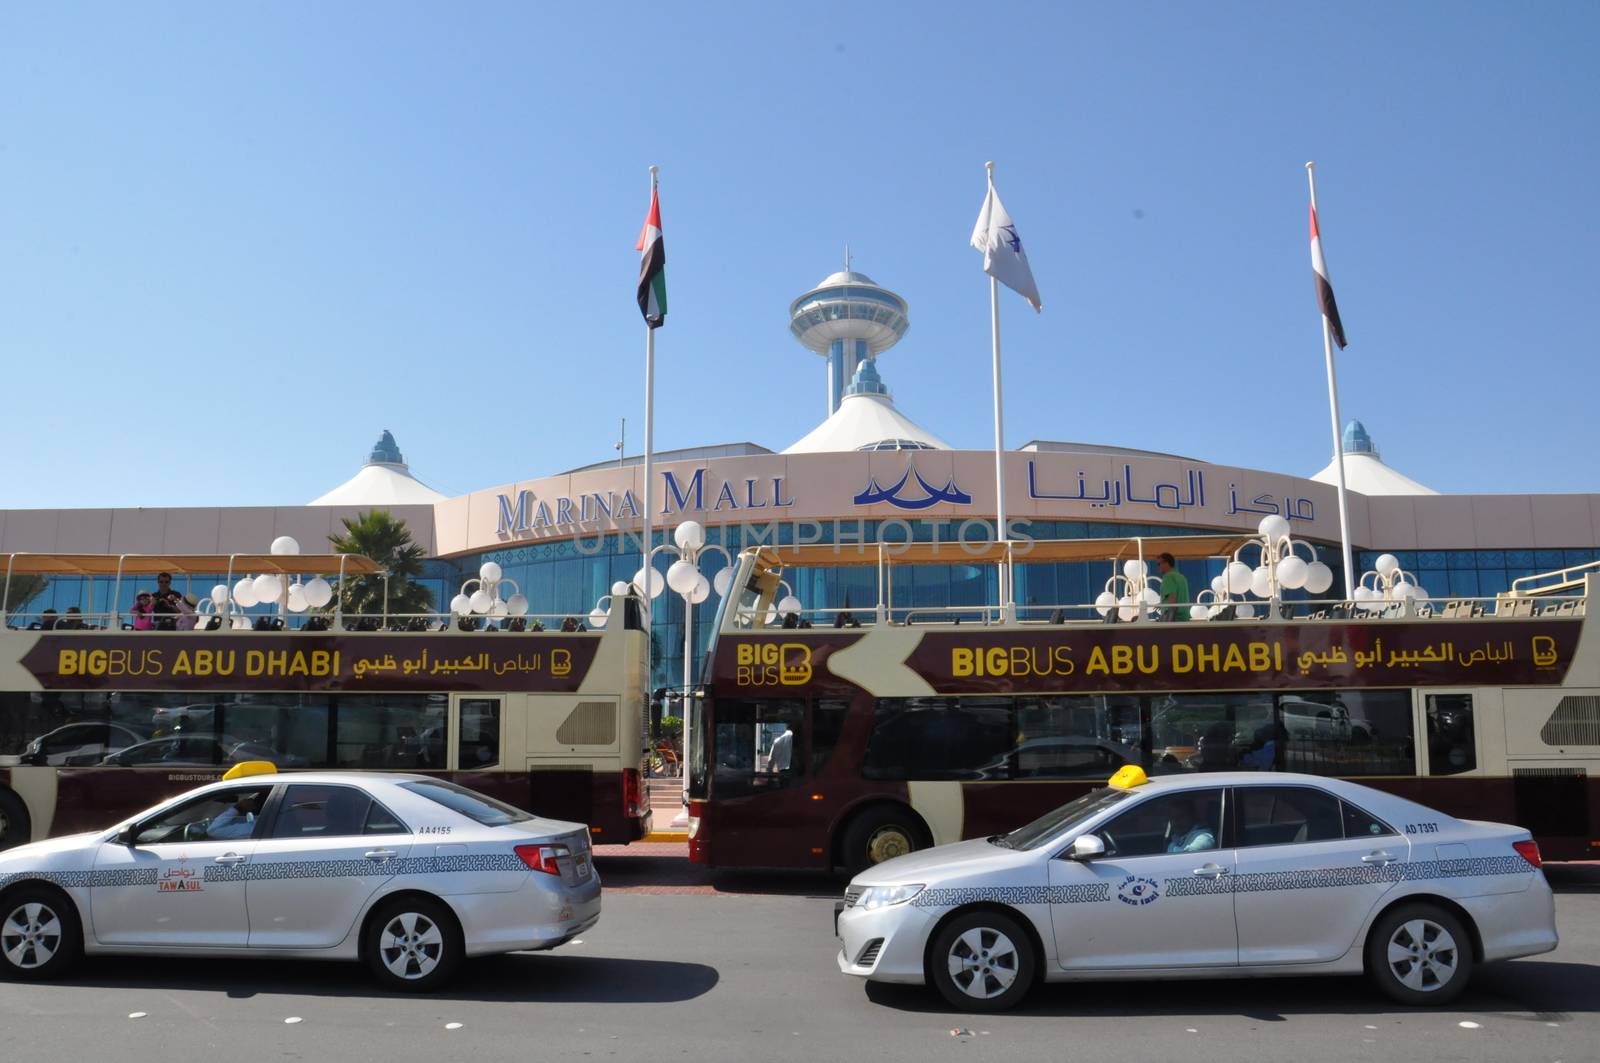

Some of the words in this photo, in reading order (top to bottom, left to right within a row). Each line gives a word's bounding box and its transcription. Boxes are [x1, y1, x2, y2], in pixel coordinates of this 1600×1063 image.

[1027, 459, 1206, 510] المارينا
[495, 489, 641, 535] MARINA
[660, 468, 795, 515] MALL
[1225, 482, 1315, 522] مركز
[171, 649, 236, 676] ABU
[245, 649, 341, 677] DHABI
[352, 654, 398, 679] ظبي
[402, 649, 428, 675] أبو
[430, 653, 489, 676] الكبير
[493, 653, 541, 676] الباص
[737, 643, 779, 665] BIG
[1085, 644, 1160, 675] ABU
[1171, 641, 1283, 674] DHABI
[1296, 645, 1349, 675] ظبي
[1353, 637, 1382, 669] أبو
[1385, 641, 1454, 668] الكبير
[1458, 640, 1514, 667] الباص
[737, 666, 779, 686] BUS
[167, 774, 222, 782] BIGBUSTOURS.C
